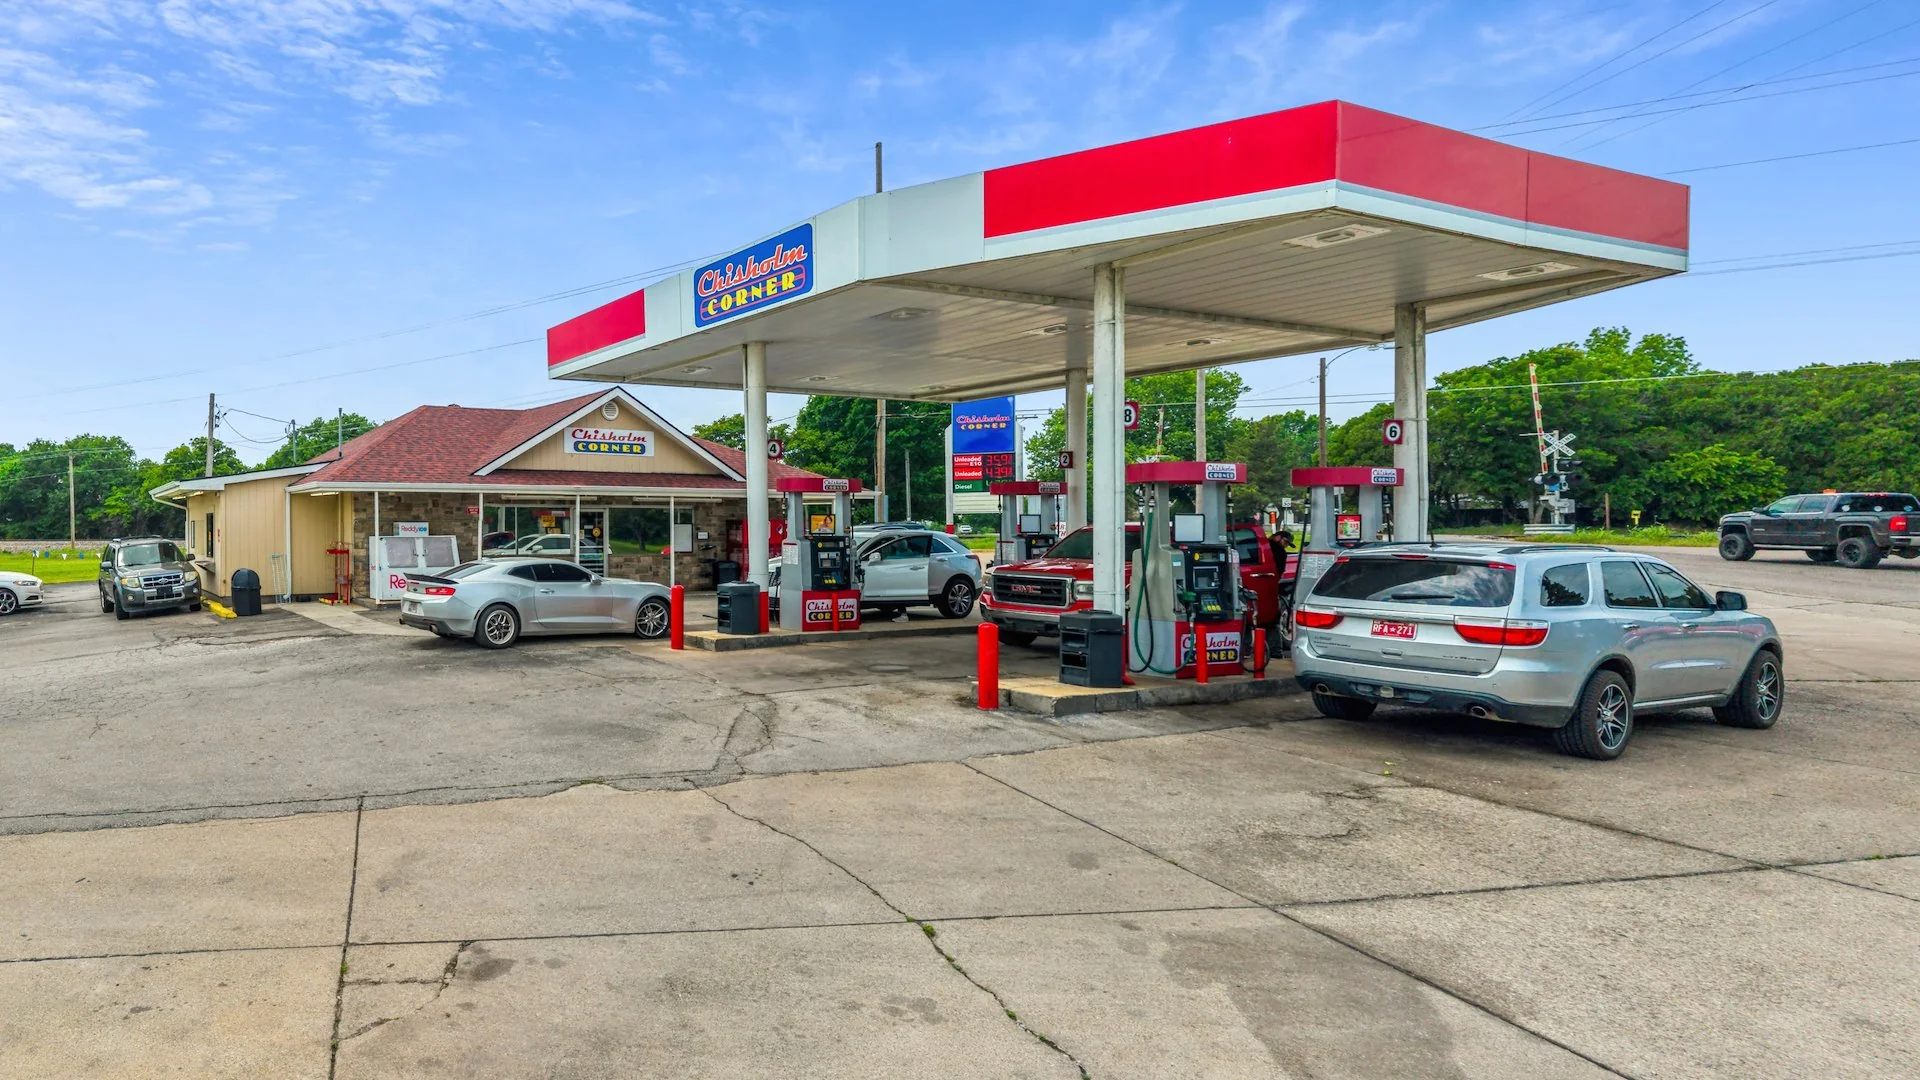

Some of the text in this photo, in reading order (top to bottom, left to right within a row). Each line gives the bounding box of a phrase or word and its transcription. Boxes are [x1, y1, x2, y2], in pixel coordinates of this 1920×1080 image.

[698, 244, 807, 296] Chisholm
[707, 271, 795, 315] CORNER
[955, 414, 1010, 424] Chisholm
[1124, 408, 1132, 423] 8
[960, 422, 1007, 430] CORNER
[1389, 425, 1398, 438] 6
[571, 428, 647, 443] Chisholm
[577, 442, 642, 453] CORNER
[769, 443, 777, 454] 4
[1062, 455, 1068, 464] 2
[807, 601, 855, 611] Chisolm
[810, 611, 852, 620] CORER
[1372, 623, 1388, 634] RFA
[1396, 625, 1413, 636] 271
[1182, 636, 1239, 649] Cholm
